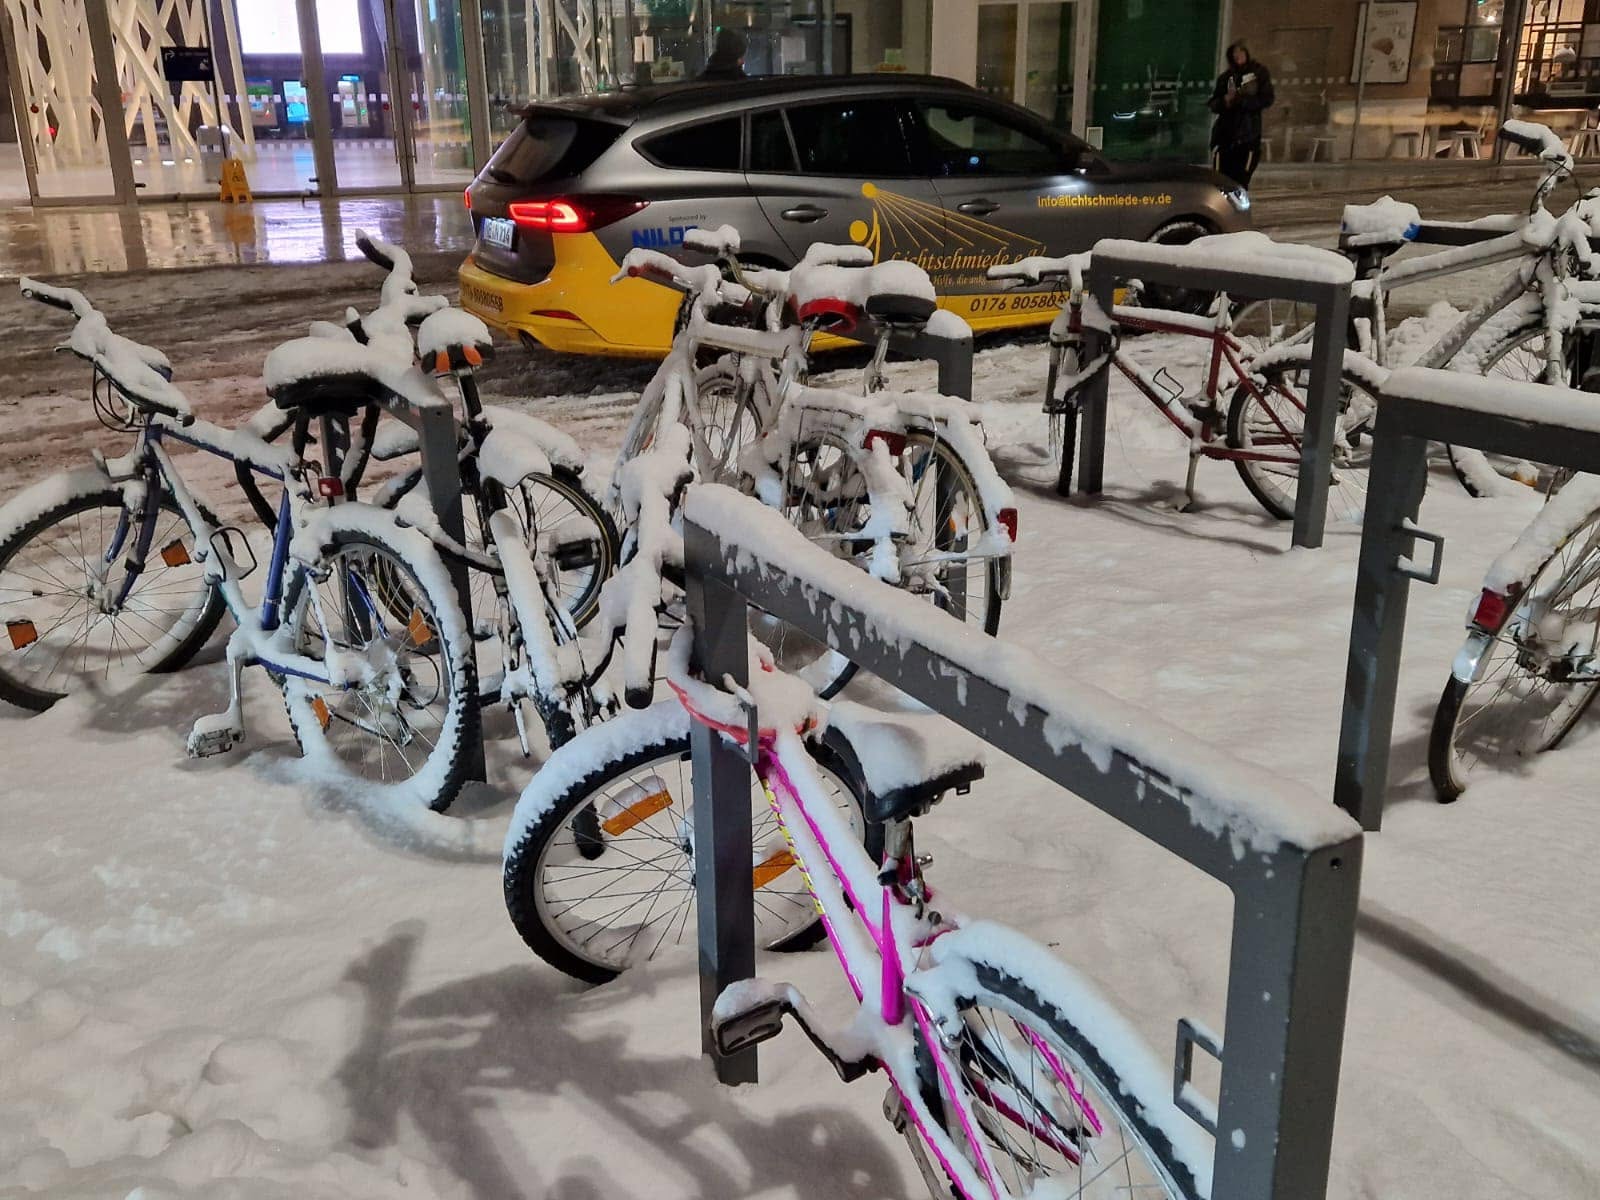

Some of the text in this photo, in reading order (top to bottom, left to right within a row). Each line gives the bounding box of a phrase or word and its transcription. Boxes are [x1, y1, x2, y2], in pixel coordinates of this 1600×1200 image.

[1037, 193, 1172, 208] info@lichtschmiede-ev.de
[631, 225, 699, 247] NILO
[969, 296, 1007, 312] 0176
